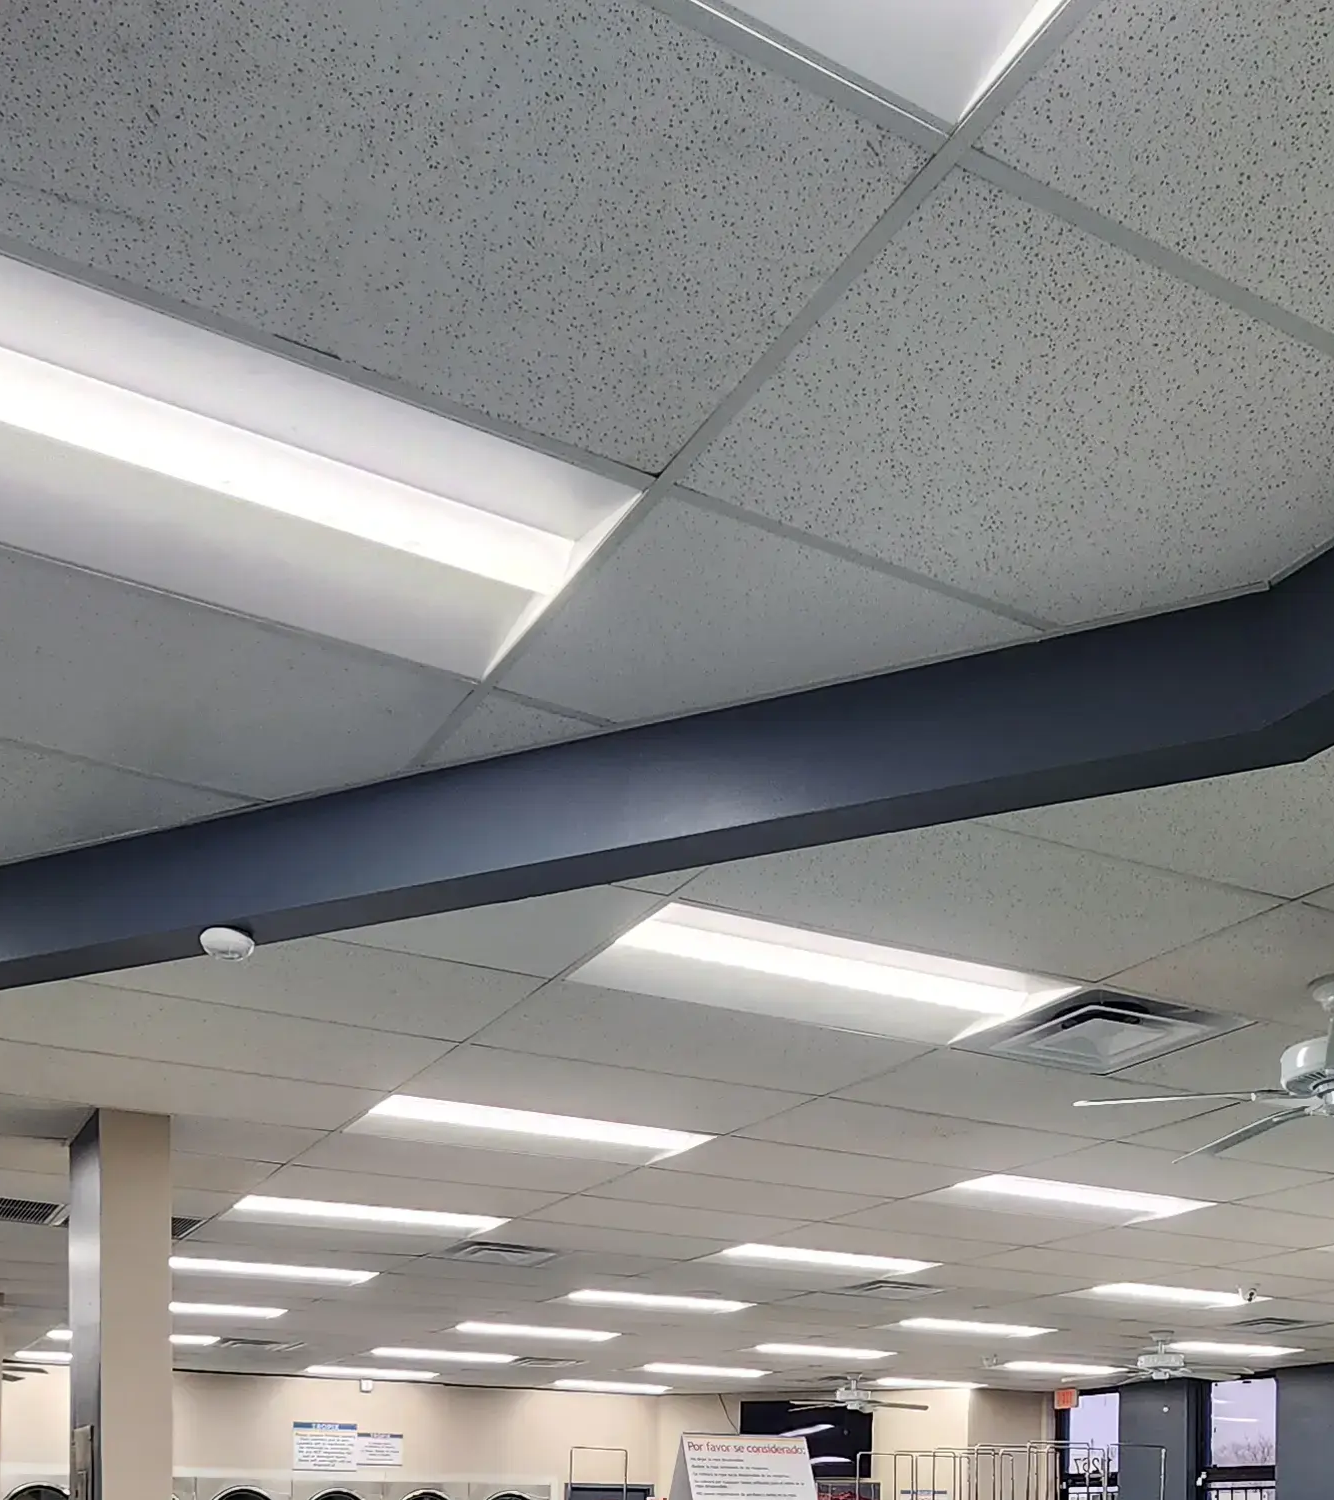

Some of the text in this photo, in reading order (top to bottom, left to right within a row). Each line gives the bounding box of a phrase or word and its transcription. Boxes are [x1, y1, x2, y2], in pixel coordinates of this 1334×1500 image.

[688, 1441, 702, 1452] Por
[706, 1441, 731, 1452] favor
[734, 1445, 744, 1453] se
